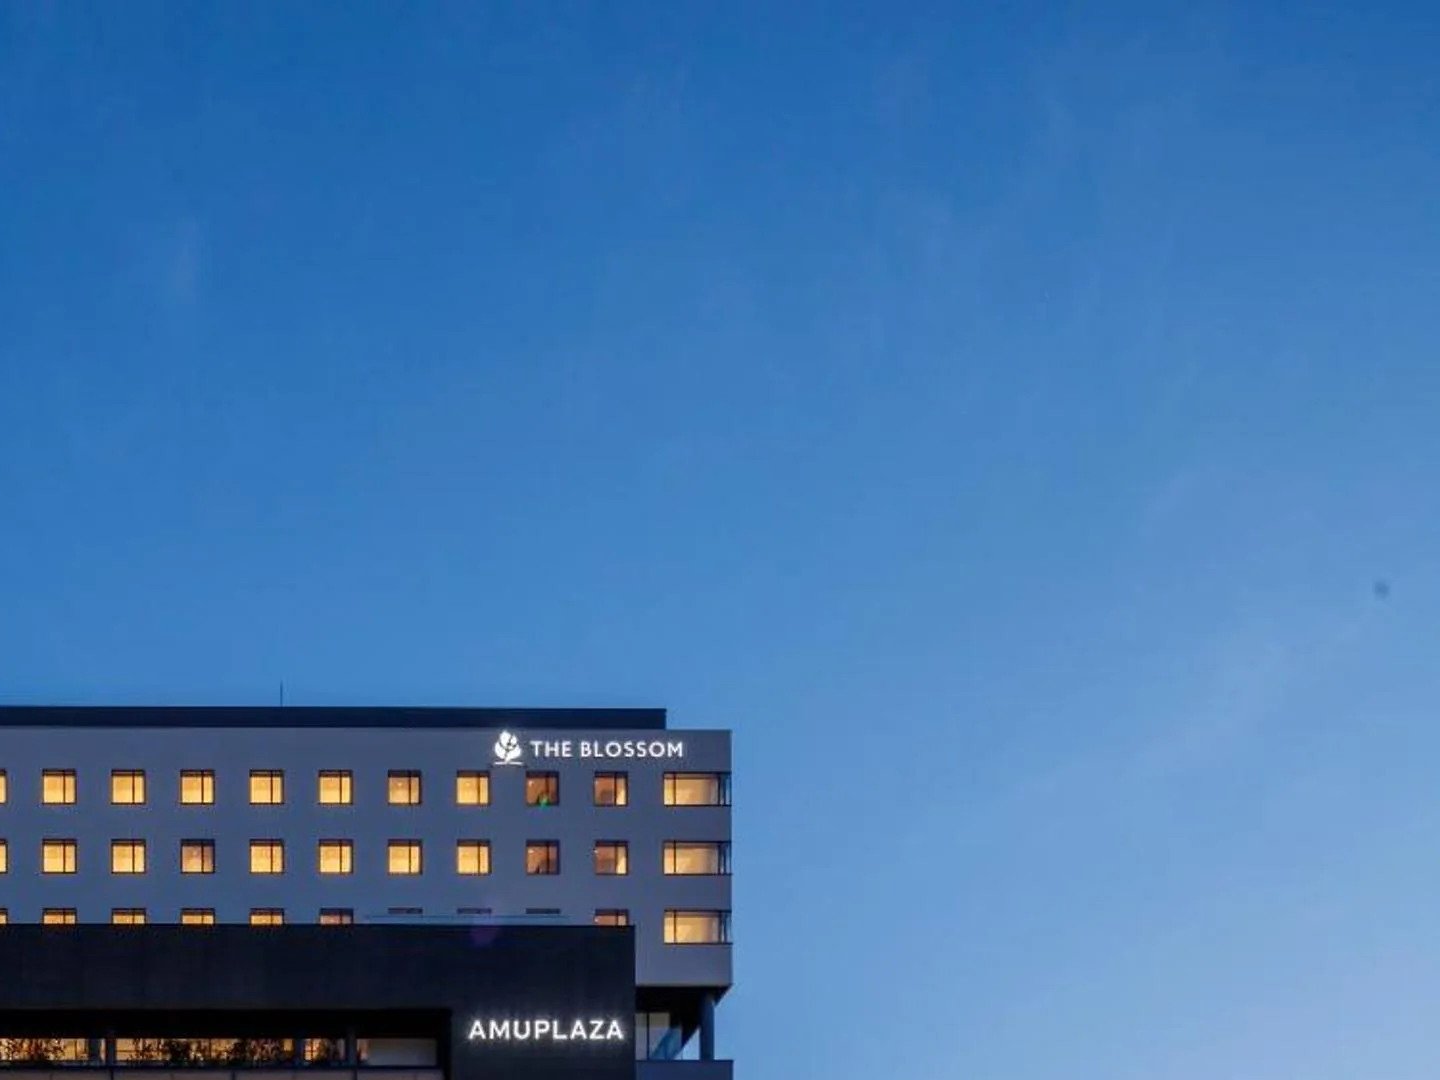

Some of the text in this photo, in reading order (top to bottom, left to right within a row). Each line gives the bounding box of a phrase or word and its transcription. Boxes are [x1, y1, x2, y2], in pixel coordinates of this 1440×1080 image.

[530, 740, 684, 758] THE BLOSSOM
[468, 1018, 625, 1040] AMUPLAZA
